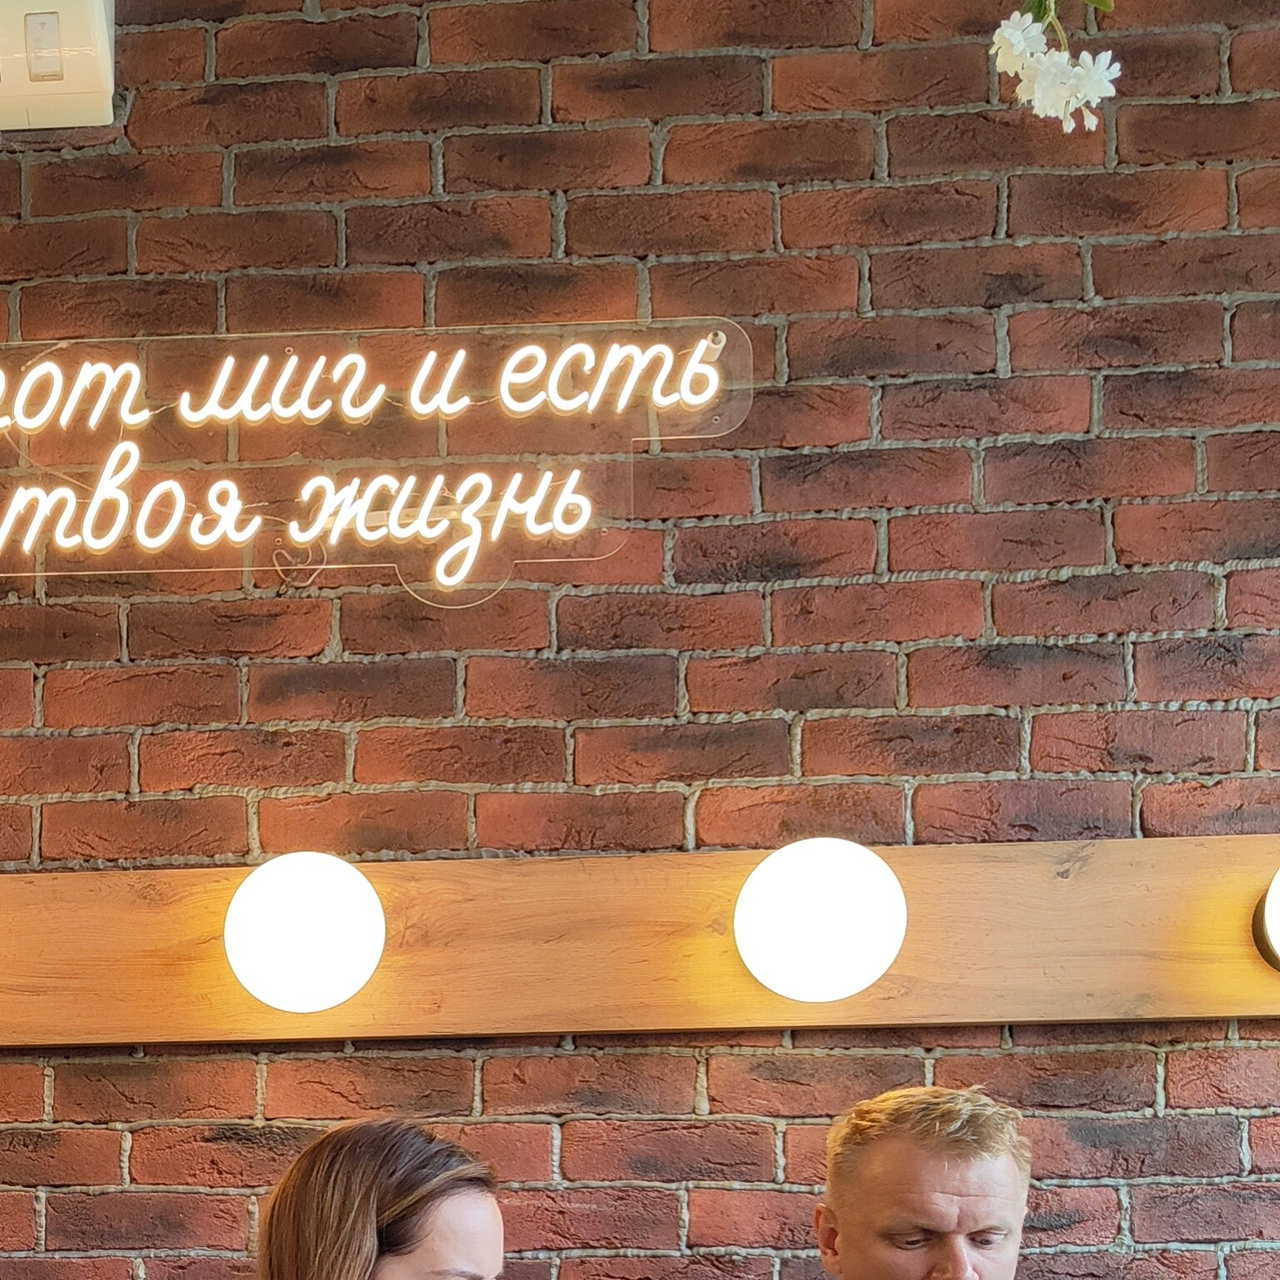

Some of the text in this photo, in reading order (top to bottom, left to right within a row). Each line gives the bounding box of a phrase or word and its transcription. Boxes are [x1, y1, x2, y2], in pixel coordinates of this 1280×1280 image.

[179, 353, 385, 424] миг
[410, 349, 470, 417] и
[499, 337, 721, 415] есть
[289, 469, 592, 587] жизнь
